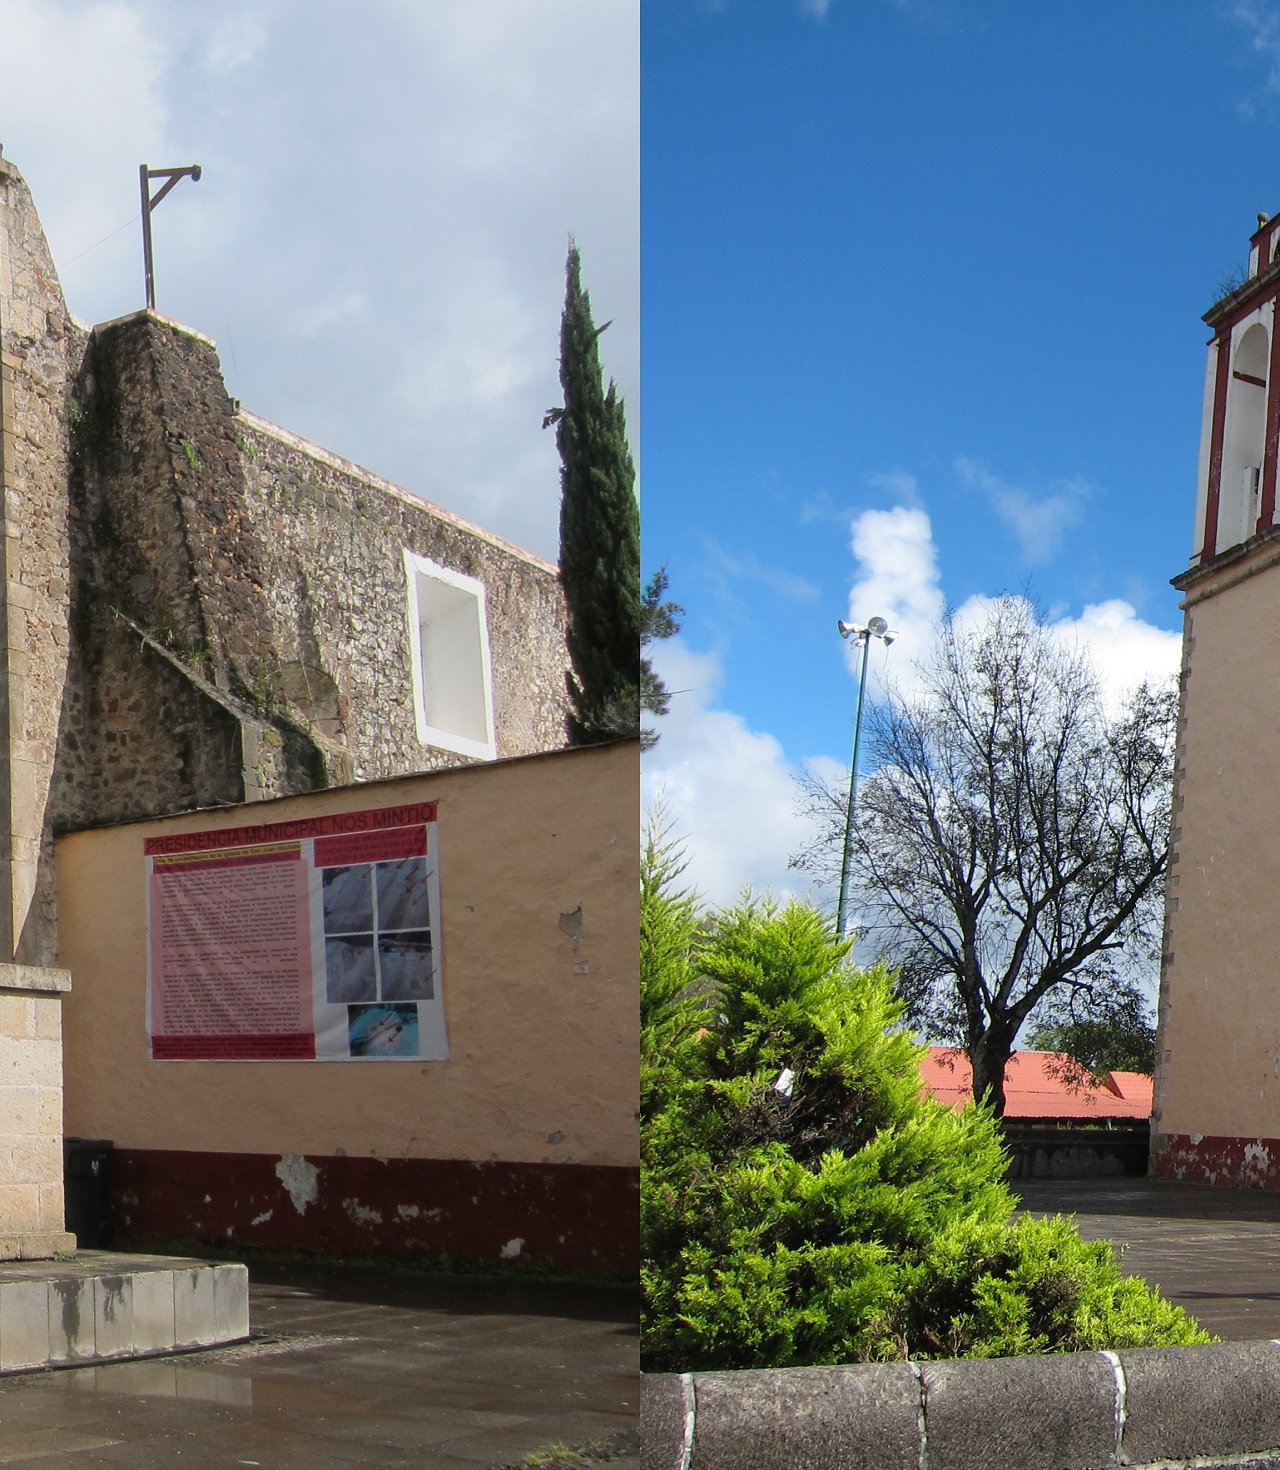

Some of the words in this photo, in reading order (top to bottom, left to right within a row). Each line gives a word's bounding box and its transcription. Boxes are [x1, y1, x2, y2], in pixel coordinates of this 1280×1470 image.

[146, 832, 241, 853] PRESIDENCIA
[244, 821, 327, 842] MUNICIPAL
[333, 815, 367, 831] NOS
